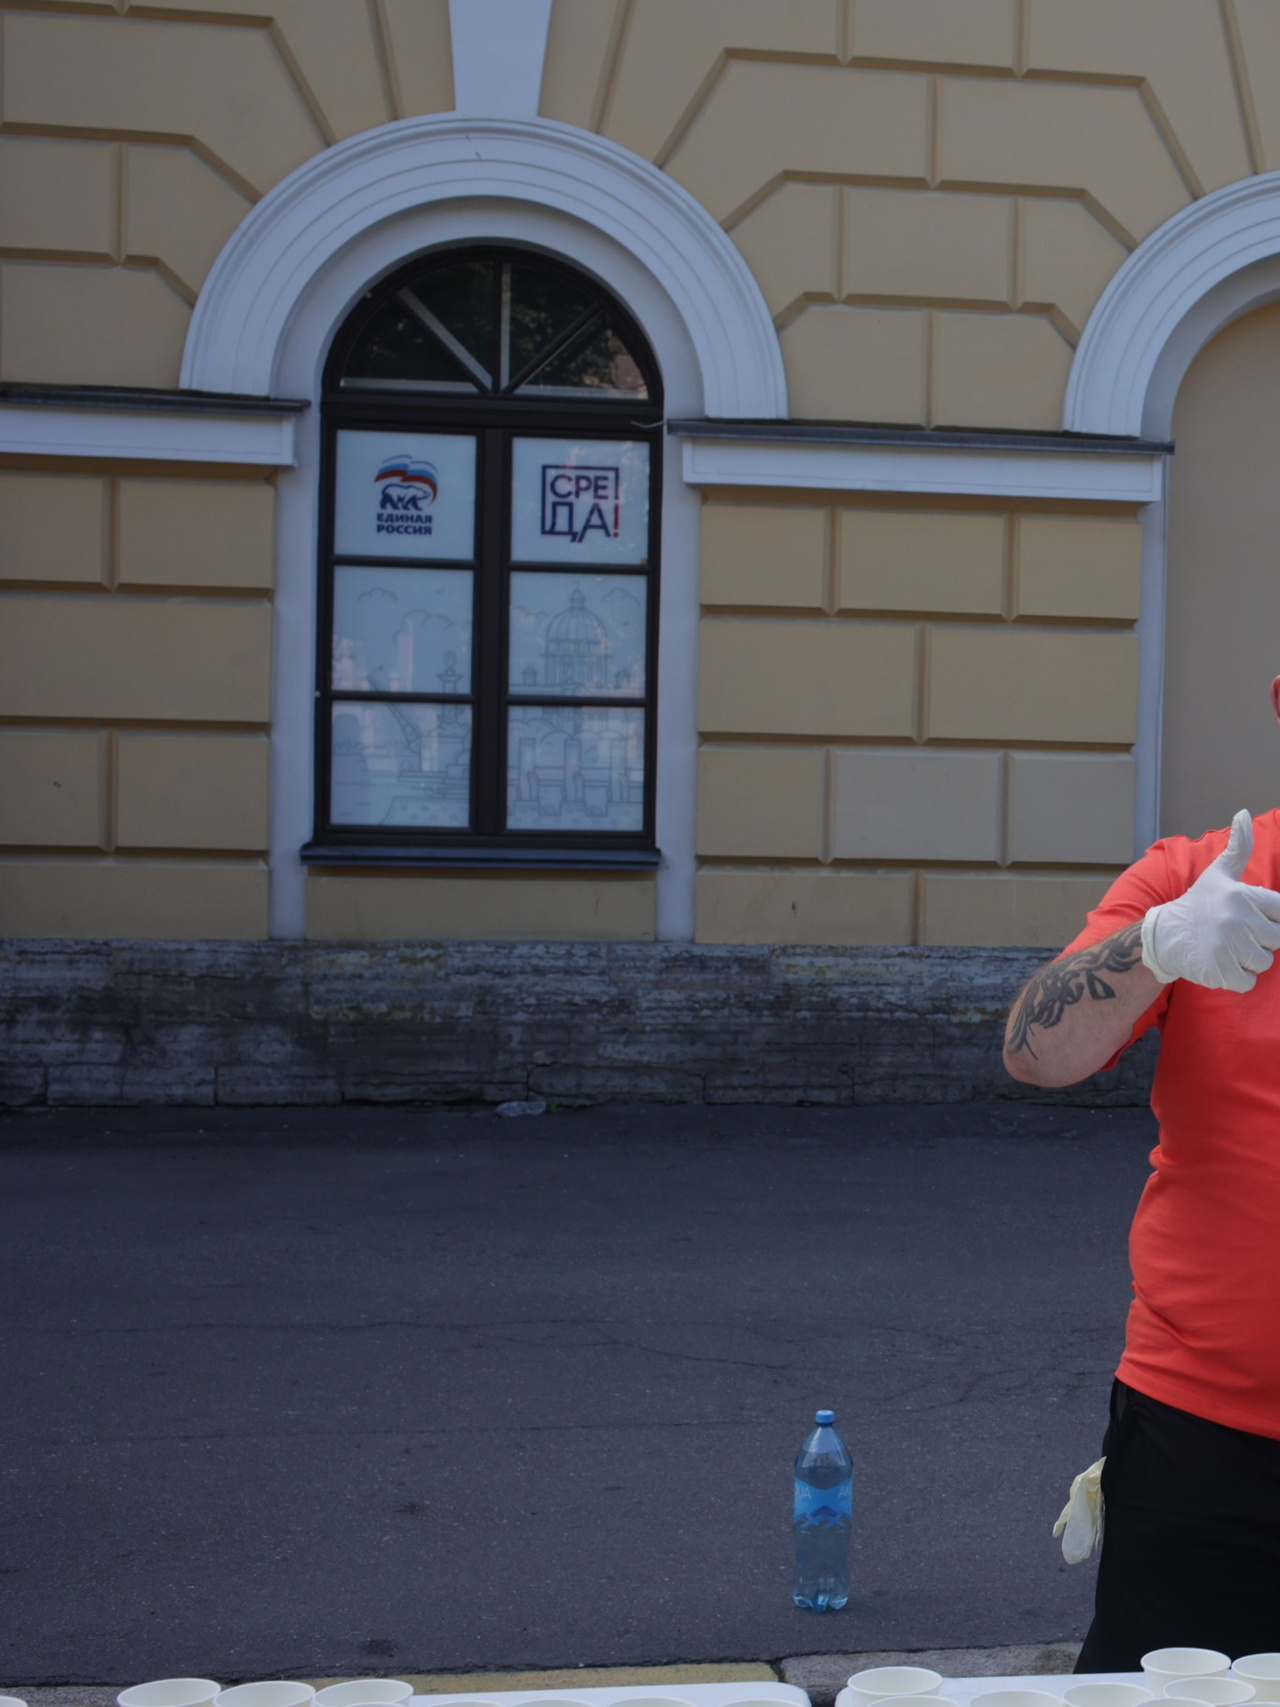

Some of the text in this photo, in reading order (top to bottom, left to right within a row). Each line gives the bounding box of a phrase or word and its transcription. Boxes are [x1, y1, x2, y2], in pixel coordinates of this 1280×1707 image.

[550, 474, 609, 499] СРЕ
[376, 512, 433, 524] ЕДИНАЯ
[547, 501, 619, 543] ДА!
[376, 524, 433, 536] РОССИЯ
